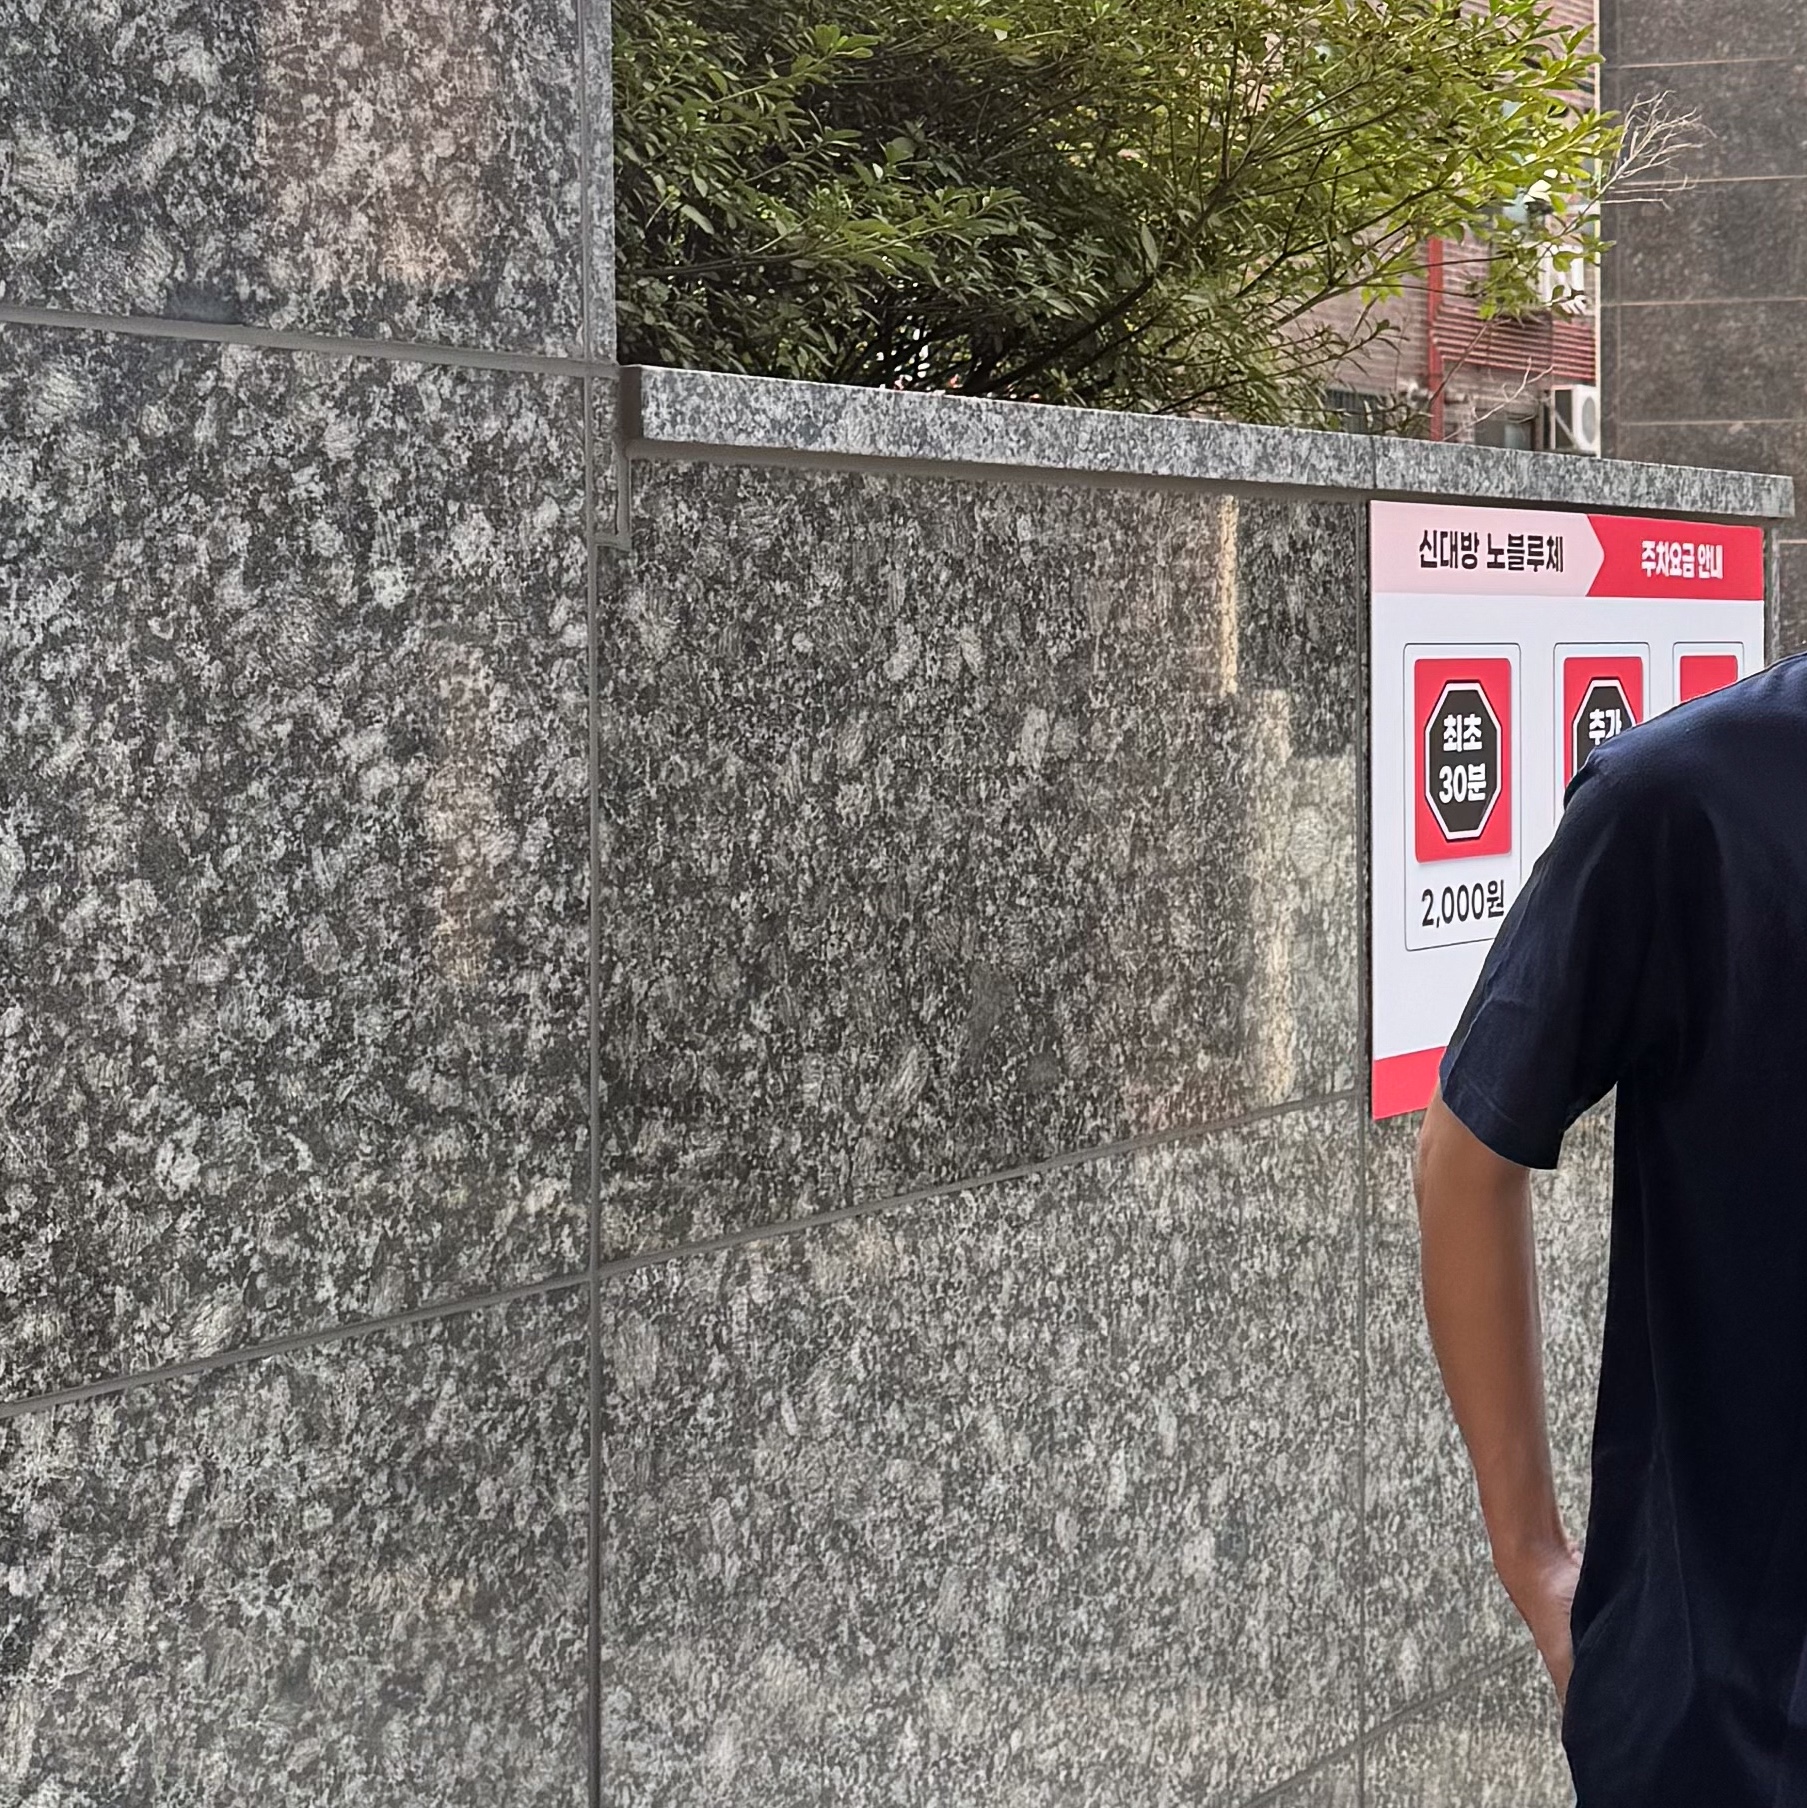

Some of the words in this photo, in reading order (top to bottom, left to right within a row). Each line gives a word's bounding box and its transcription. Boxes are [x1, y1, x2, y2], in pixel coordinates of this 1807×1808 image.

[1419, 529, 1480, 570] 신대방
[1486, 532, 1564, 573] 노블루체
[1641, 540, 1695, 578] 주차요금
[1697, 543, 1723, 580] 안내
[1443, 713, 1483, 752] 최초
[1438, 762, 1487, 804] 30분
[1421, 879, 1504, 928] 2,000원
